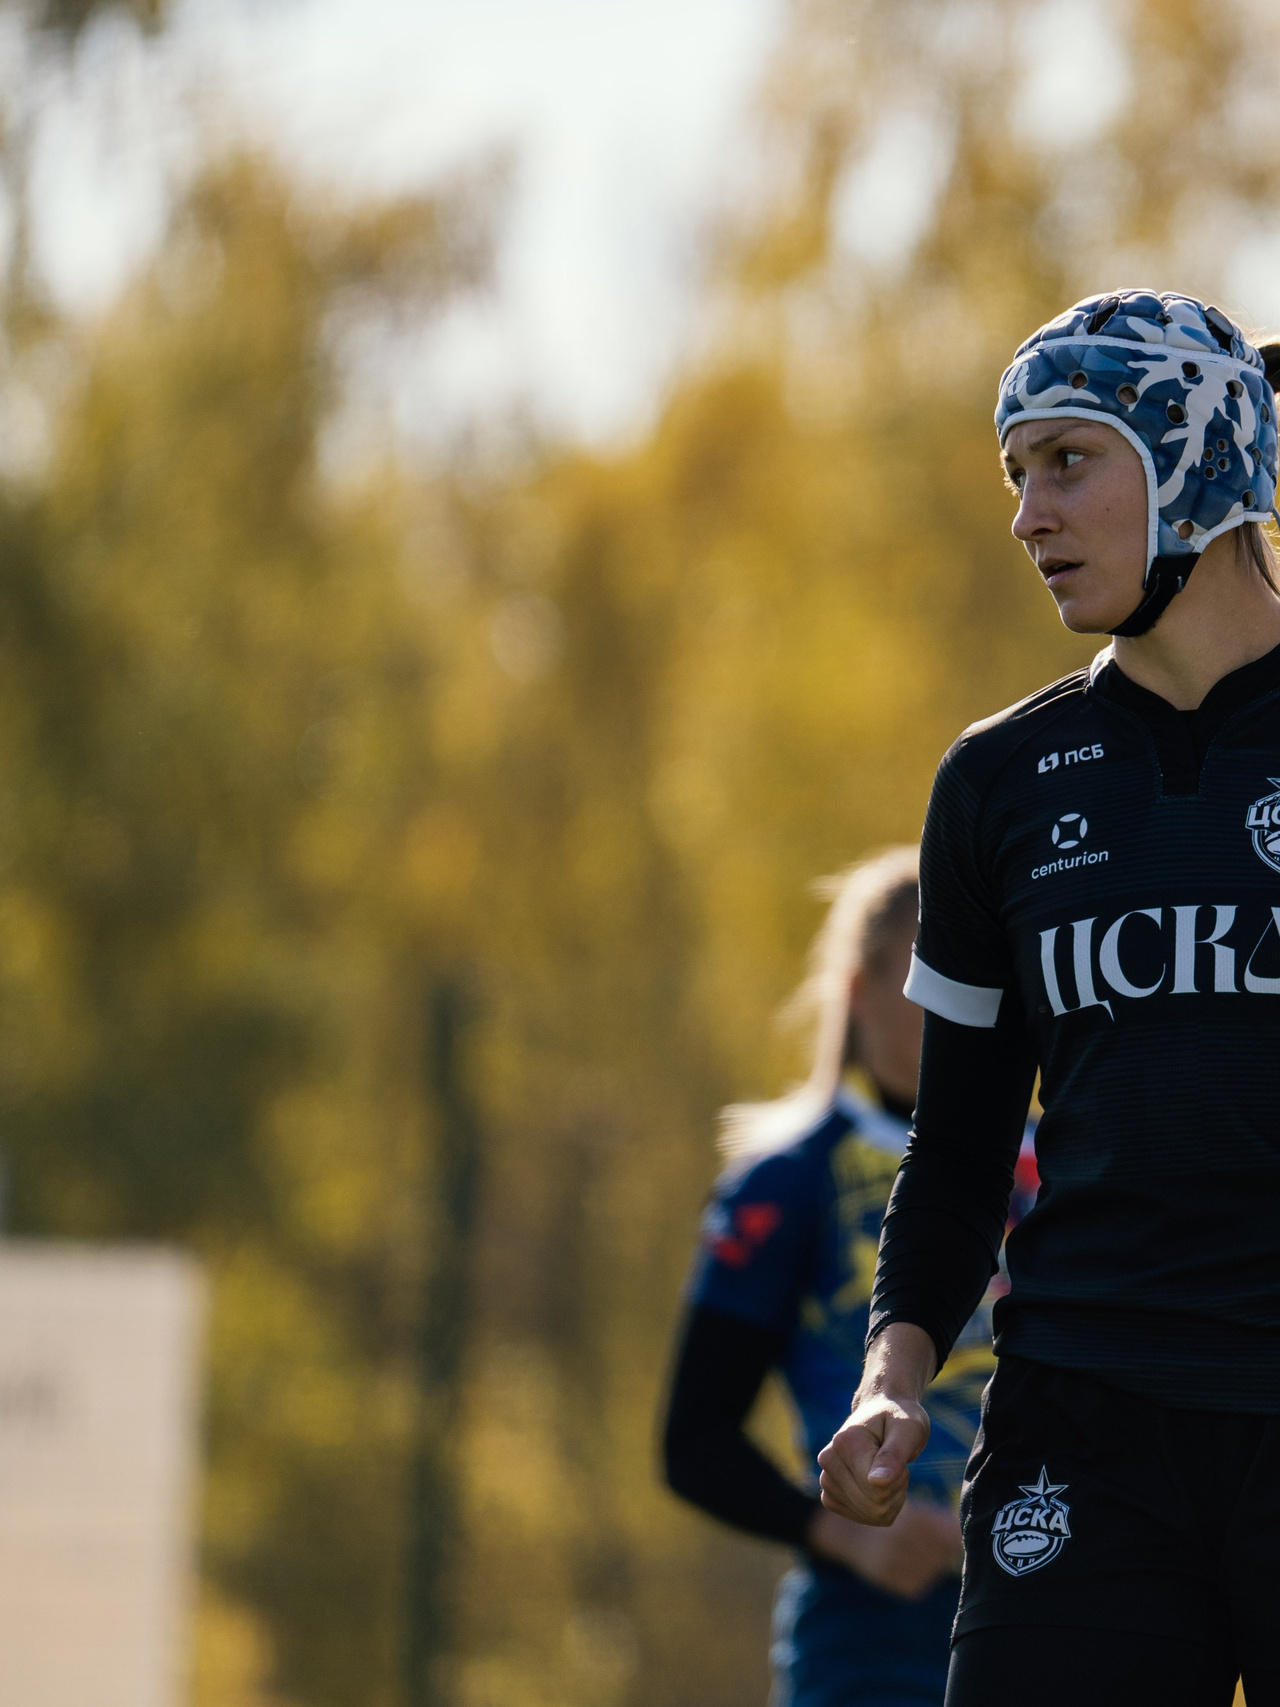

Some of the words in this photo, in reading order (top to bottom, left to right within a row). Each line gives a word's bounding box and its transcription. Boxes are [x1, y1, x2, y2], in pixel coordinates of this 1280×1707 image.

[1064, 743, 1104, 765] ПСБ
[1031, 850, 1109, 879] centurion
[993, 1507, 1069, 1535] ЦСКА
